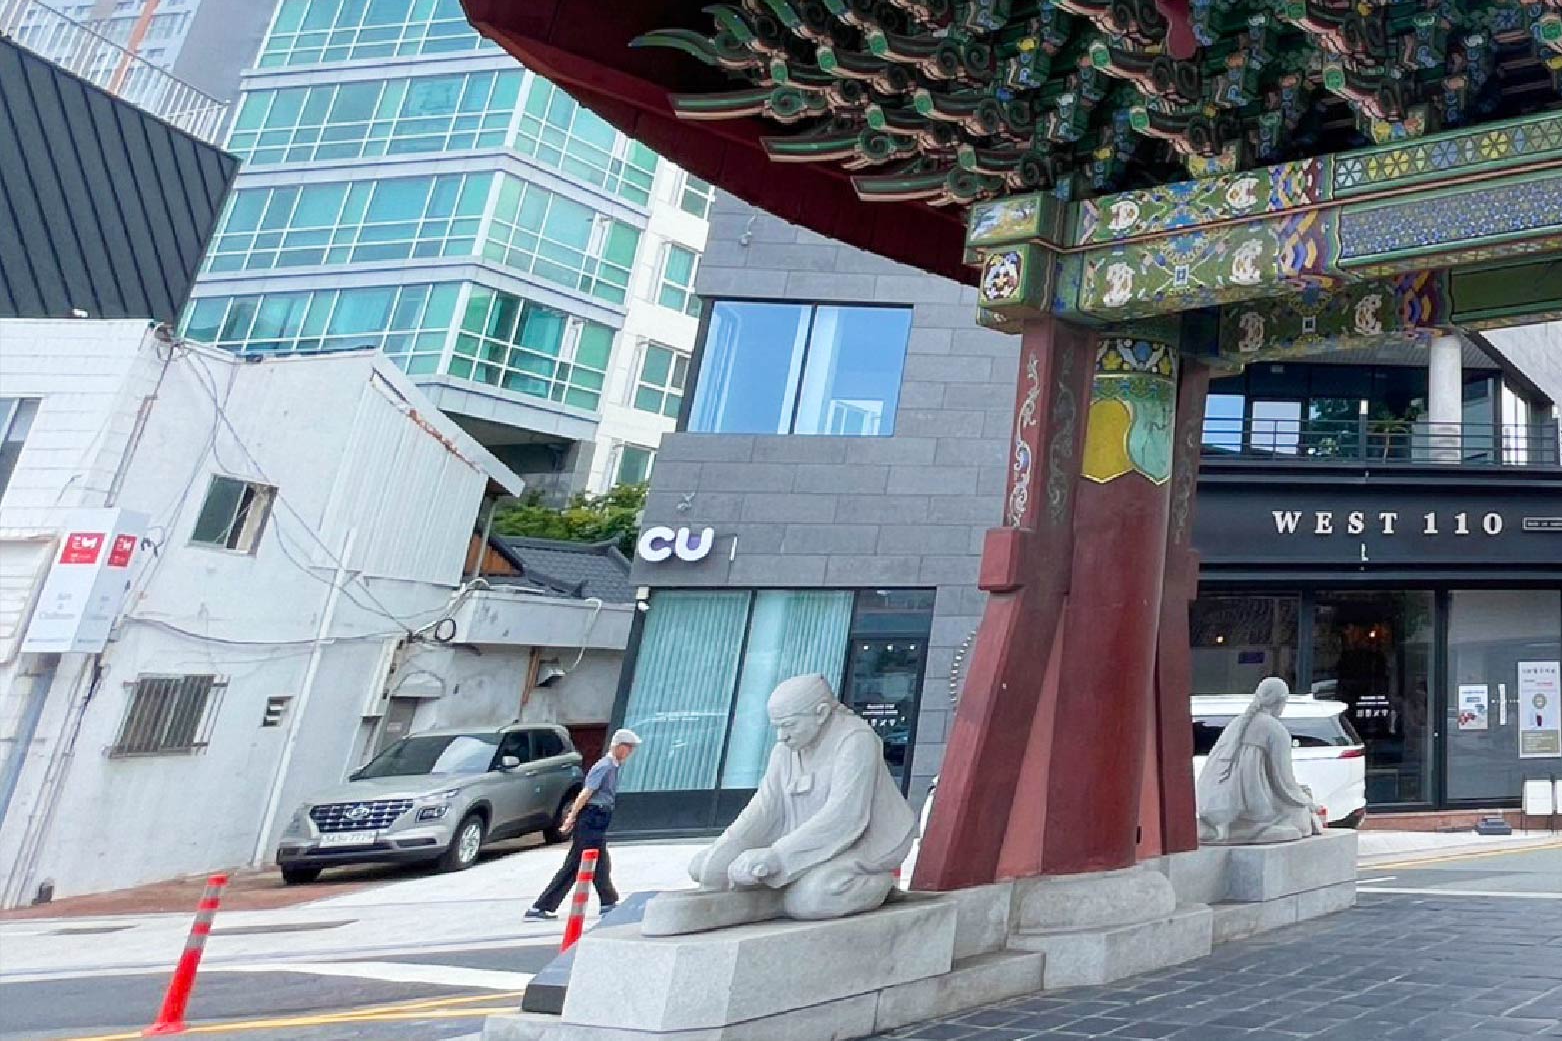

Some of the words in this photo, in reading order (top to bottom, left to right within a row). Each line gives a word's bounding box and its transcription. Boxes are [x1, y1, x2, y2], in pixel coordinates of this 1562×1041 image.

[1271, 510, 1398, 535] WEST
[1423, 511, 1504, 535] 110
[638, 526, 715, 562] CU
